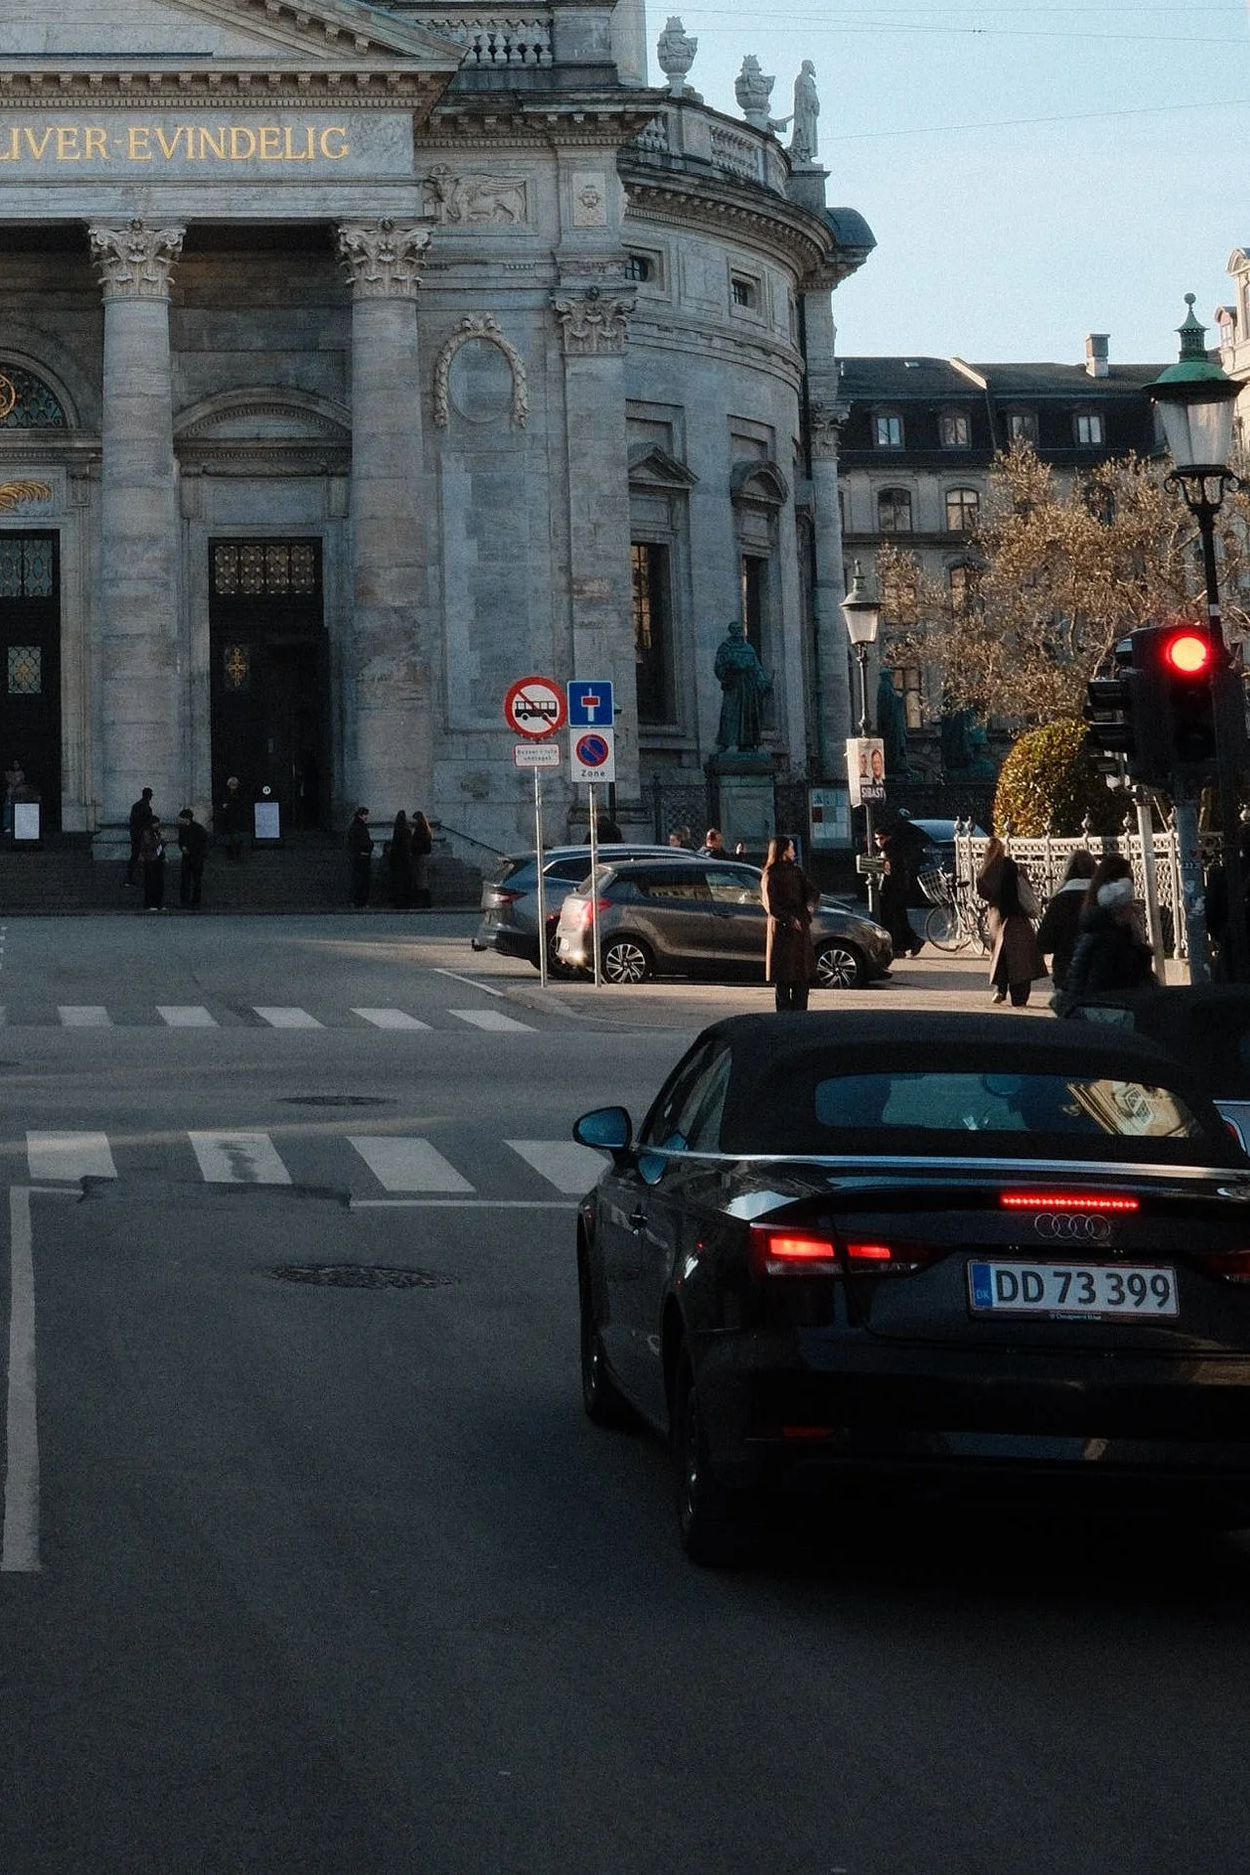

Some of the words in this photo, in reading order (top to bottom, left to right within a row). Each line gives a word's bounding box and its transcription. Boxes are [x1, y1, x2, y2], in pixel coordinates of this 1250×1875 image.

[128, 126, 350, 160] EVINDELIG
[581, 769, 606, 778] Zone
[976, 1289, 990, 1300] DK
[995, 1269, 1045, 1303] DD
[1053, 1271, 1097, 1305] 73
[1105, 1273, 1171, 1308] 399
